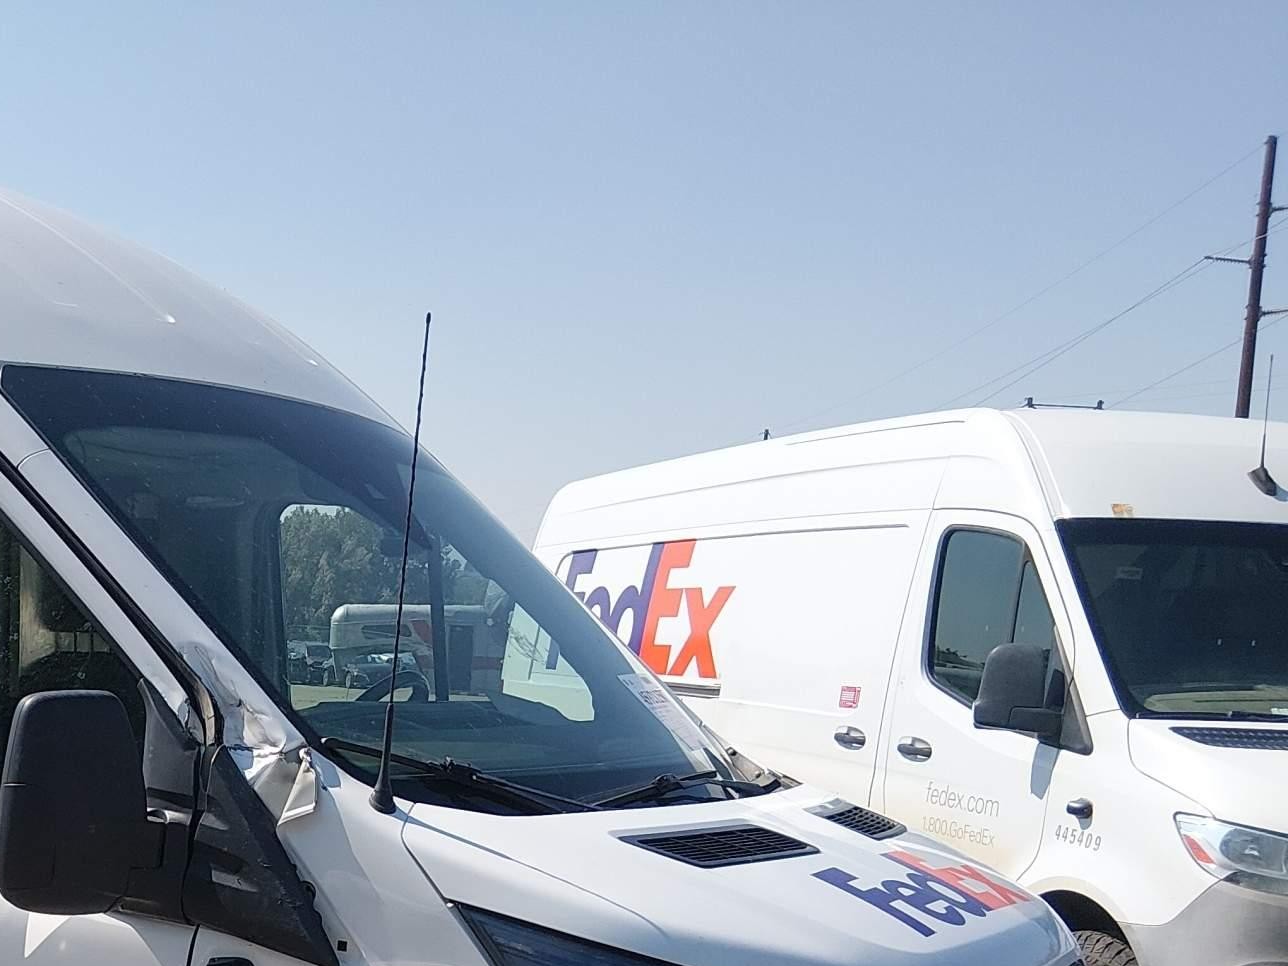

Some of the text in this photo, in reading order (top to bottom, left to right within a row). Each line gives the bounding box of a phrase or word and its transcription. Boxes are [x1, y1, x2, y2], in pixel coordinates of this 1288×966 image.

[924, 781, 1000, 818] fedex.com
[921, 815, 996, 849] 1.800.GoFedEx
[1054, 824, 1102, 852] 445409
[809, 850, 1031, 938] FedEx
